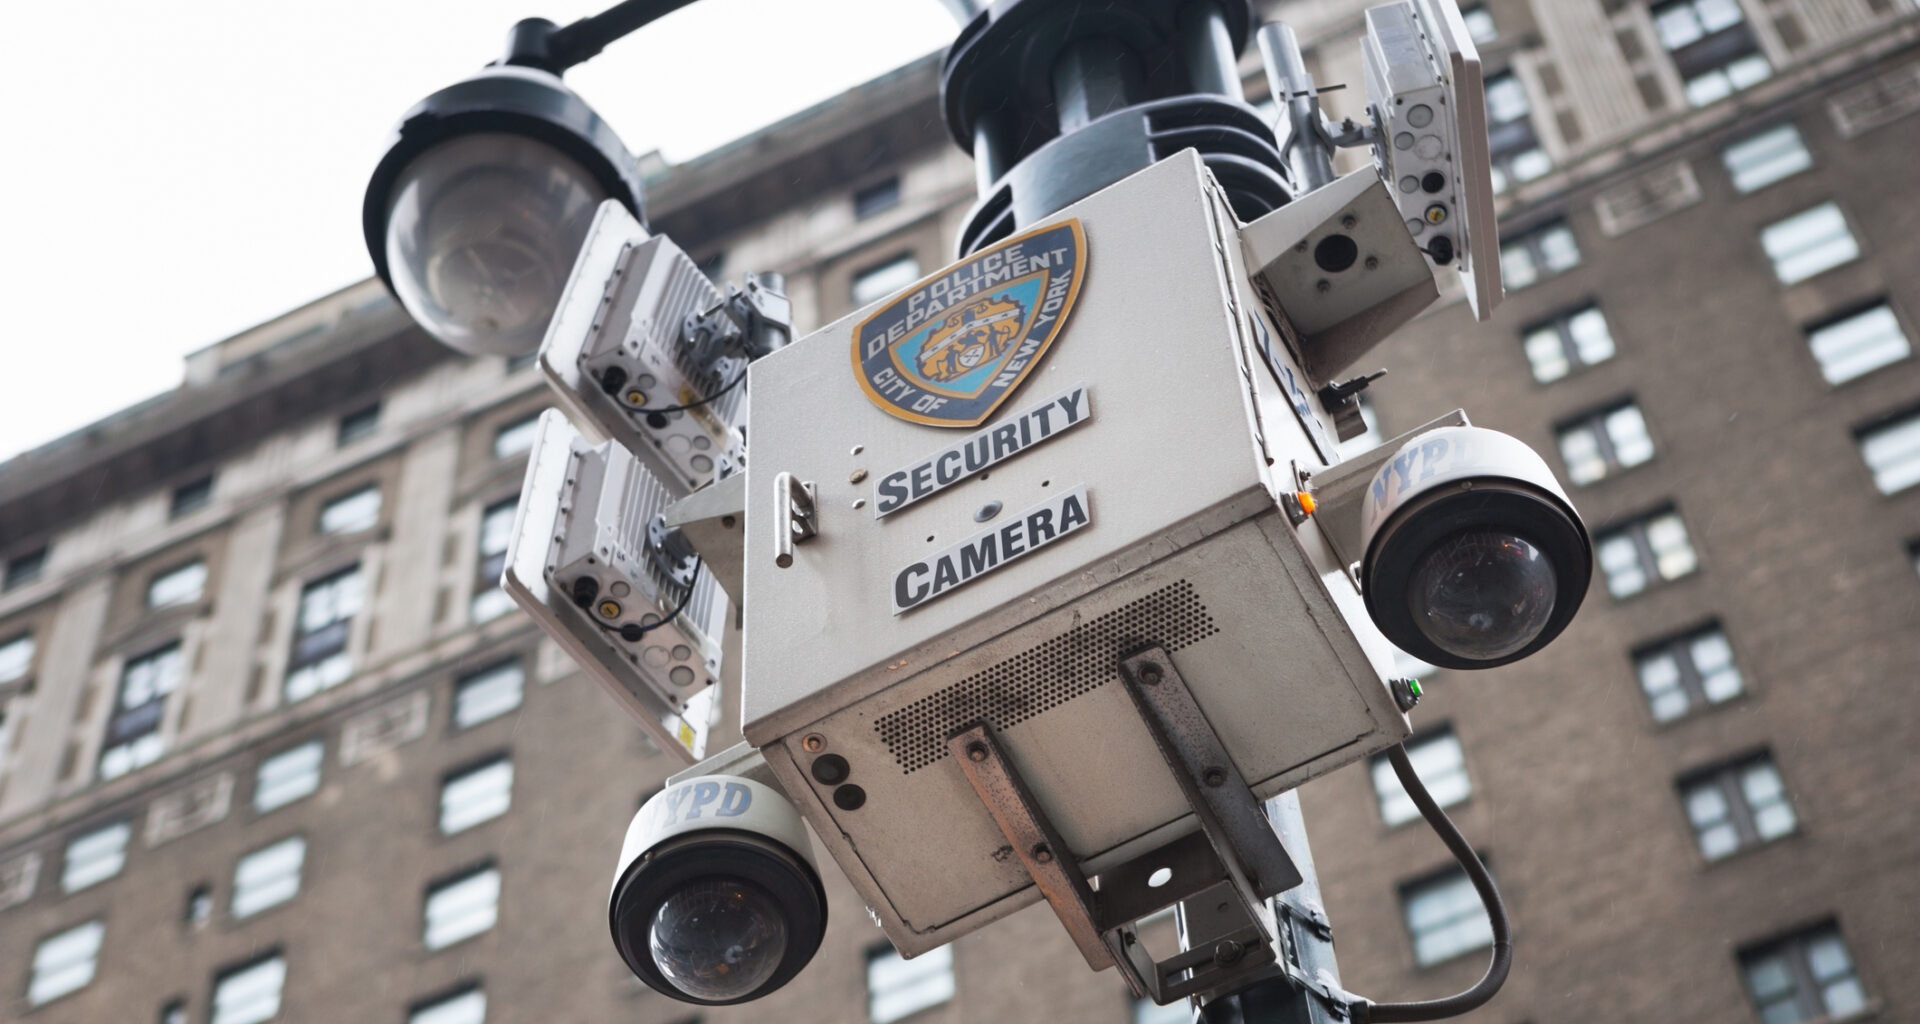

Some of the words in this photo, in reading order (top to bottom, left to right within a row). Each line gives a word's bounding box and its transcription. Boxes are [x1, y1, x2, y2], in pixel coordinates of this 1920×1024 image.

[867, 248, 1068, 359] DEPARTMENT
[908, 243, 1024, 312] POLICE
[992, 338, 1040, 388] NEW
[1033, 269, 1072, 329] YORK
[873, 368, 916, 402] CITY
[912, 394, 949, 413] OF
[878, 388, 1082, 512] SECURITY
[895, 494, 1087, 608] CAMERA
[650, 781, 752, 829] YPD
